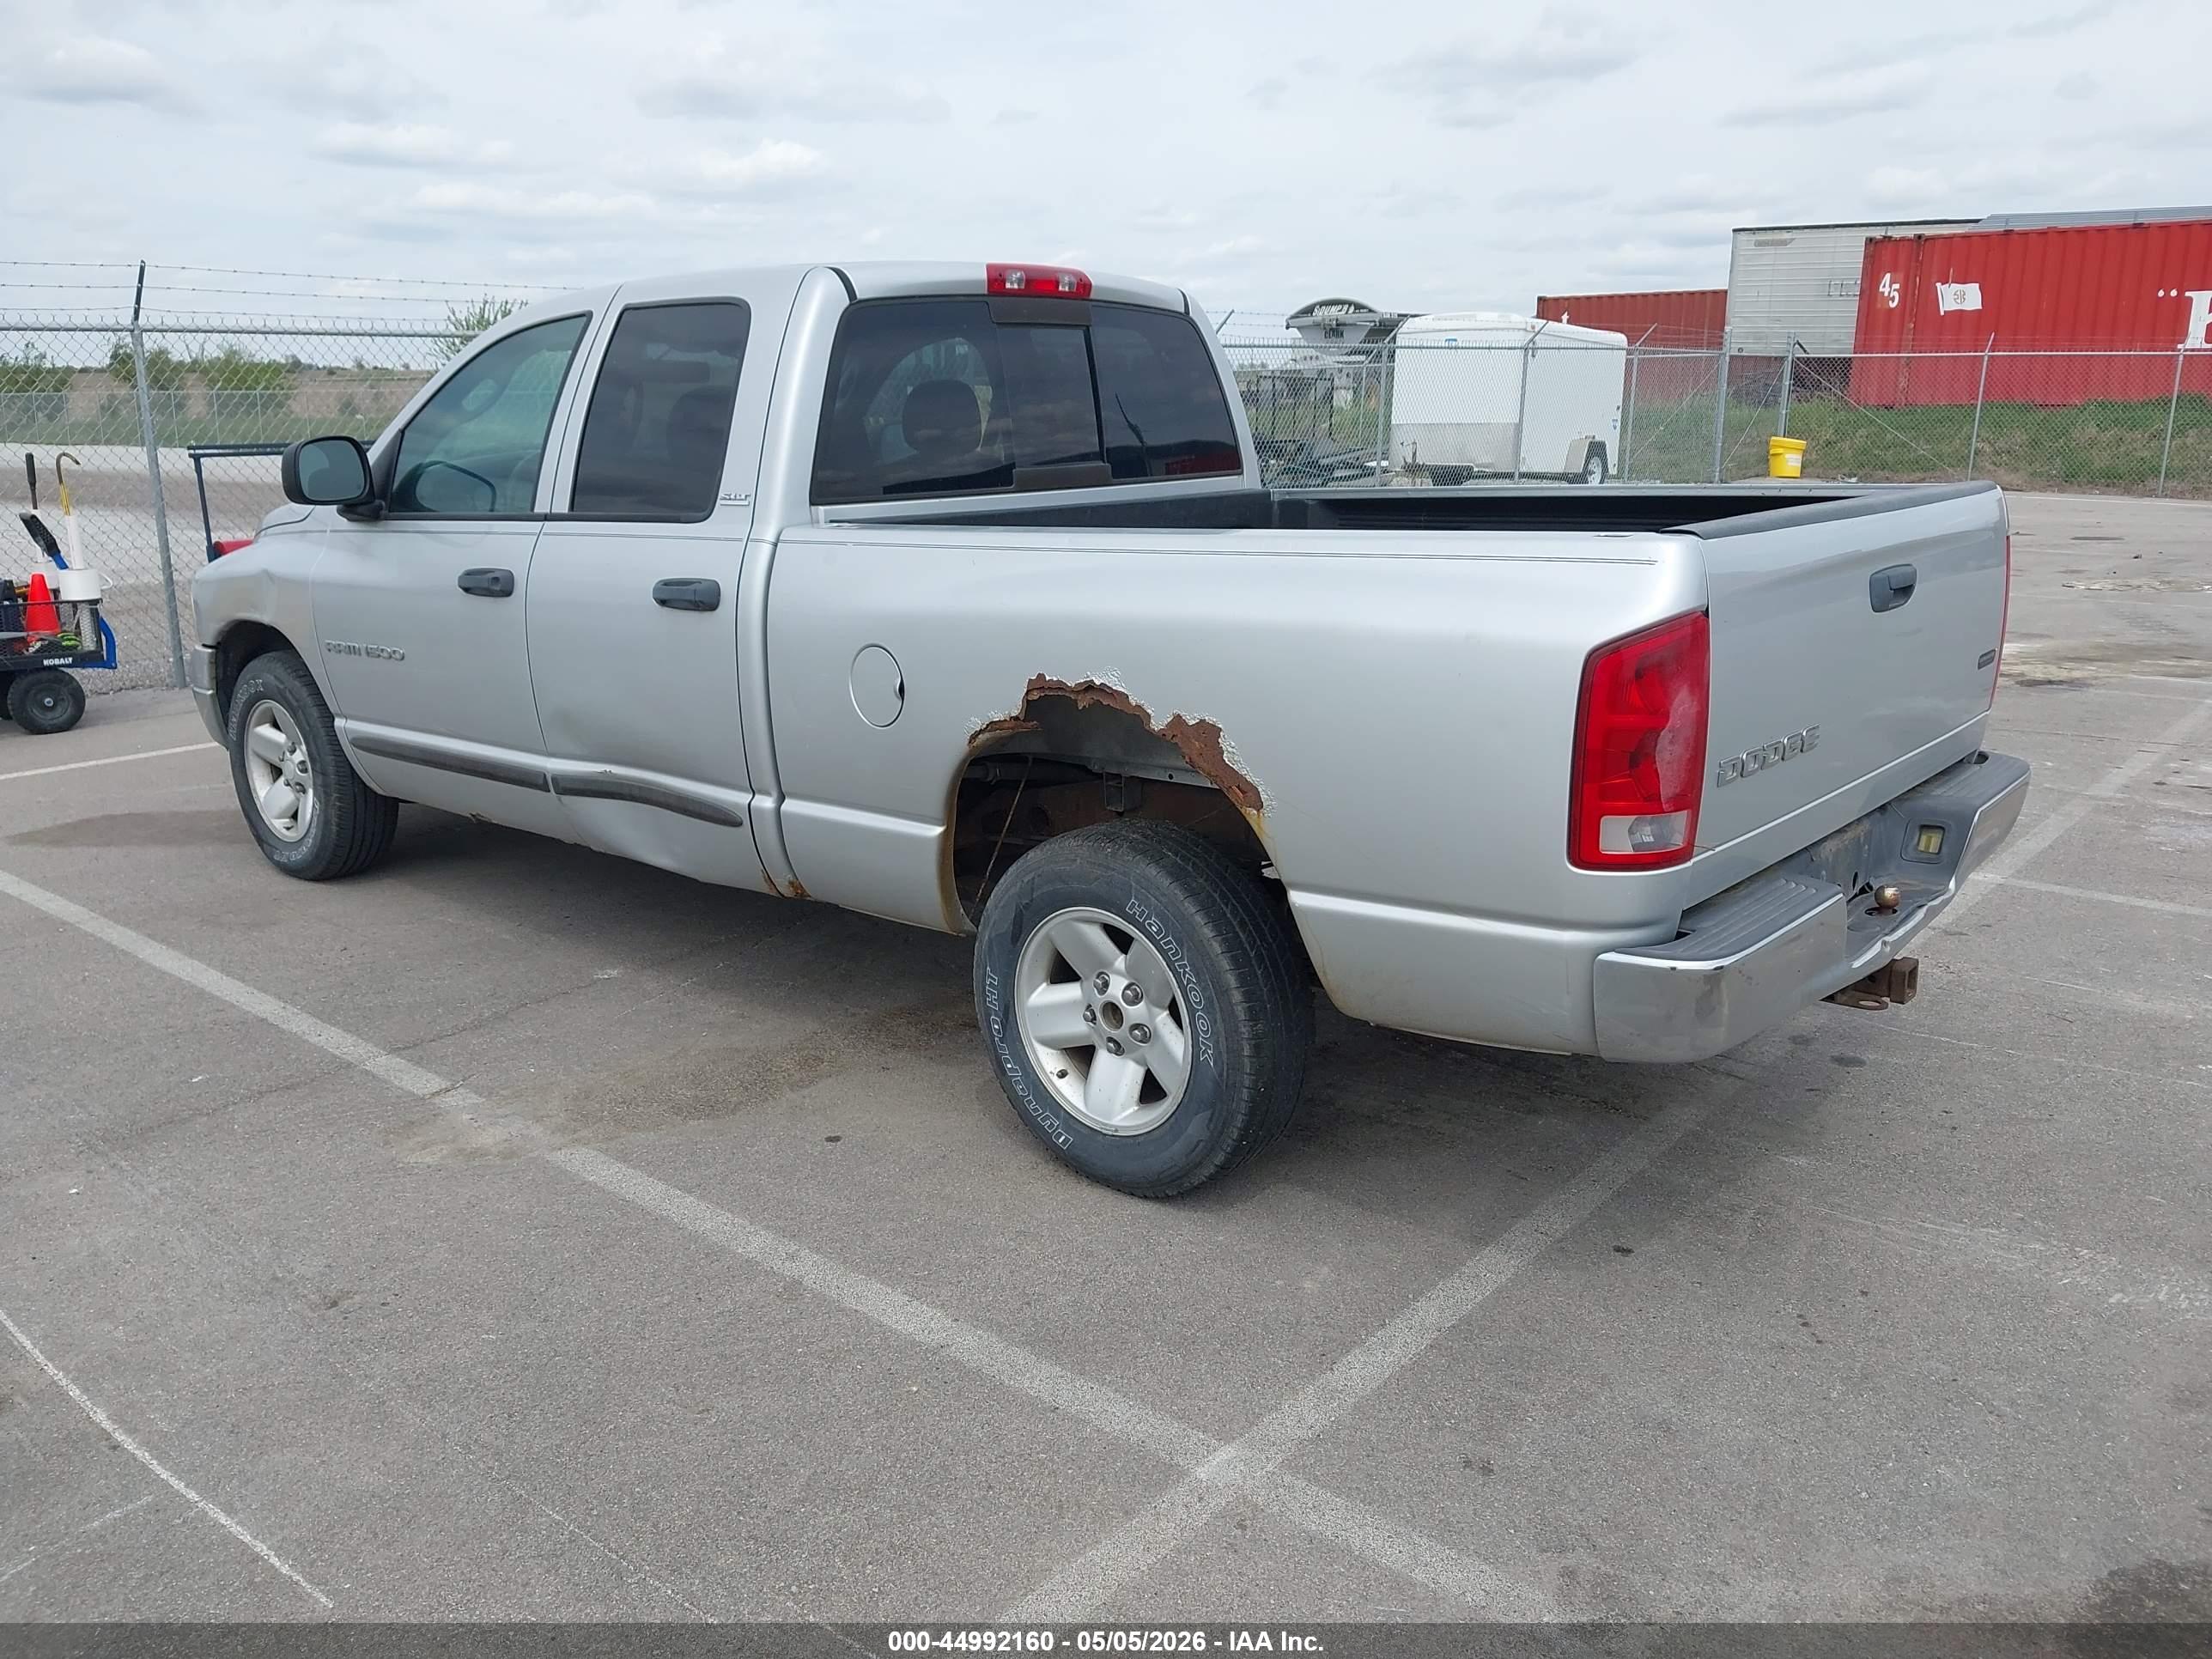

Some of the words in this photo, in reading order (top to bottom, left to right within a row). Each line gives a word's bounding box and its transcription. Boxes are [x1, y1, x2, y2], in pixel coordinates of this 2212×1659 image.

[43, 657, 73, 666] KOBALT
[325, 640, 362, 657] RAM
[362, 643, 405, 662] 1500
[1717, 723, 1821, 787] DODGE
[985, 967, 1000, 1011] HT
